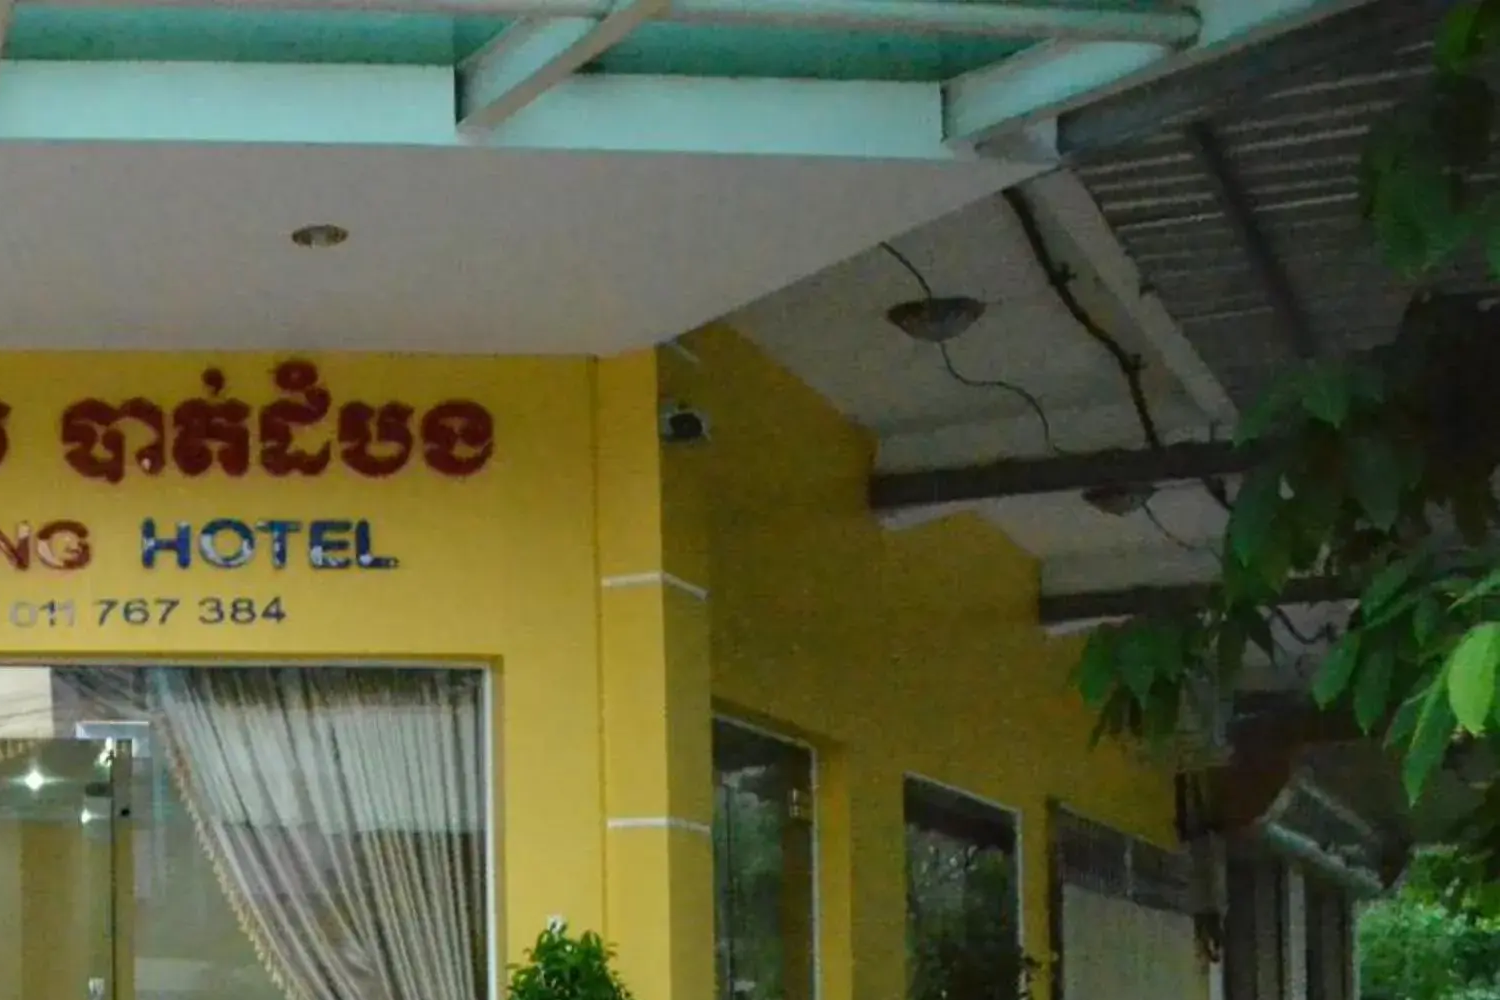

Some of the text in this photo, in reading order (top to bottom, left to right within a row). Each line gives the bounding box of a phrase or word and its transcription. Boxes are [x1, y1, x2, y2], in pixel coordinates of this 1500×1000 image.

[141, 519, 398, 569] HOTEL
[10, 598, 77, 627] 011
[98, 598, 181, 625] 767
[198, 598, 287, 624] 384
